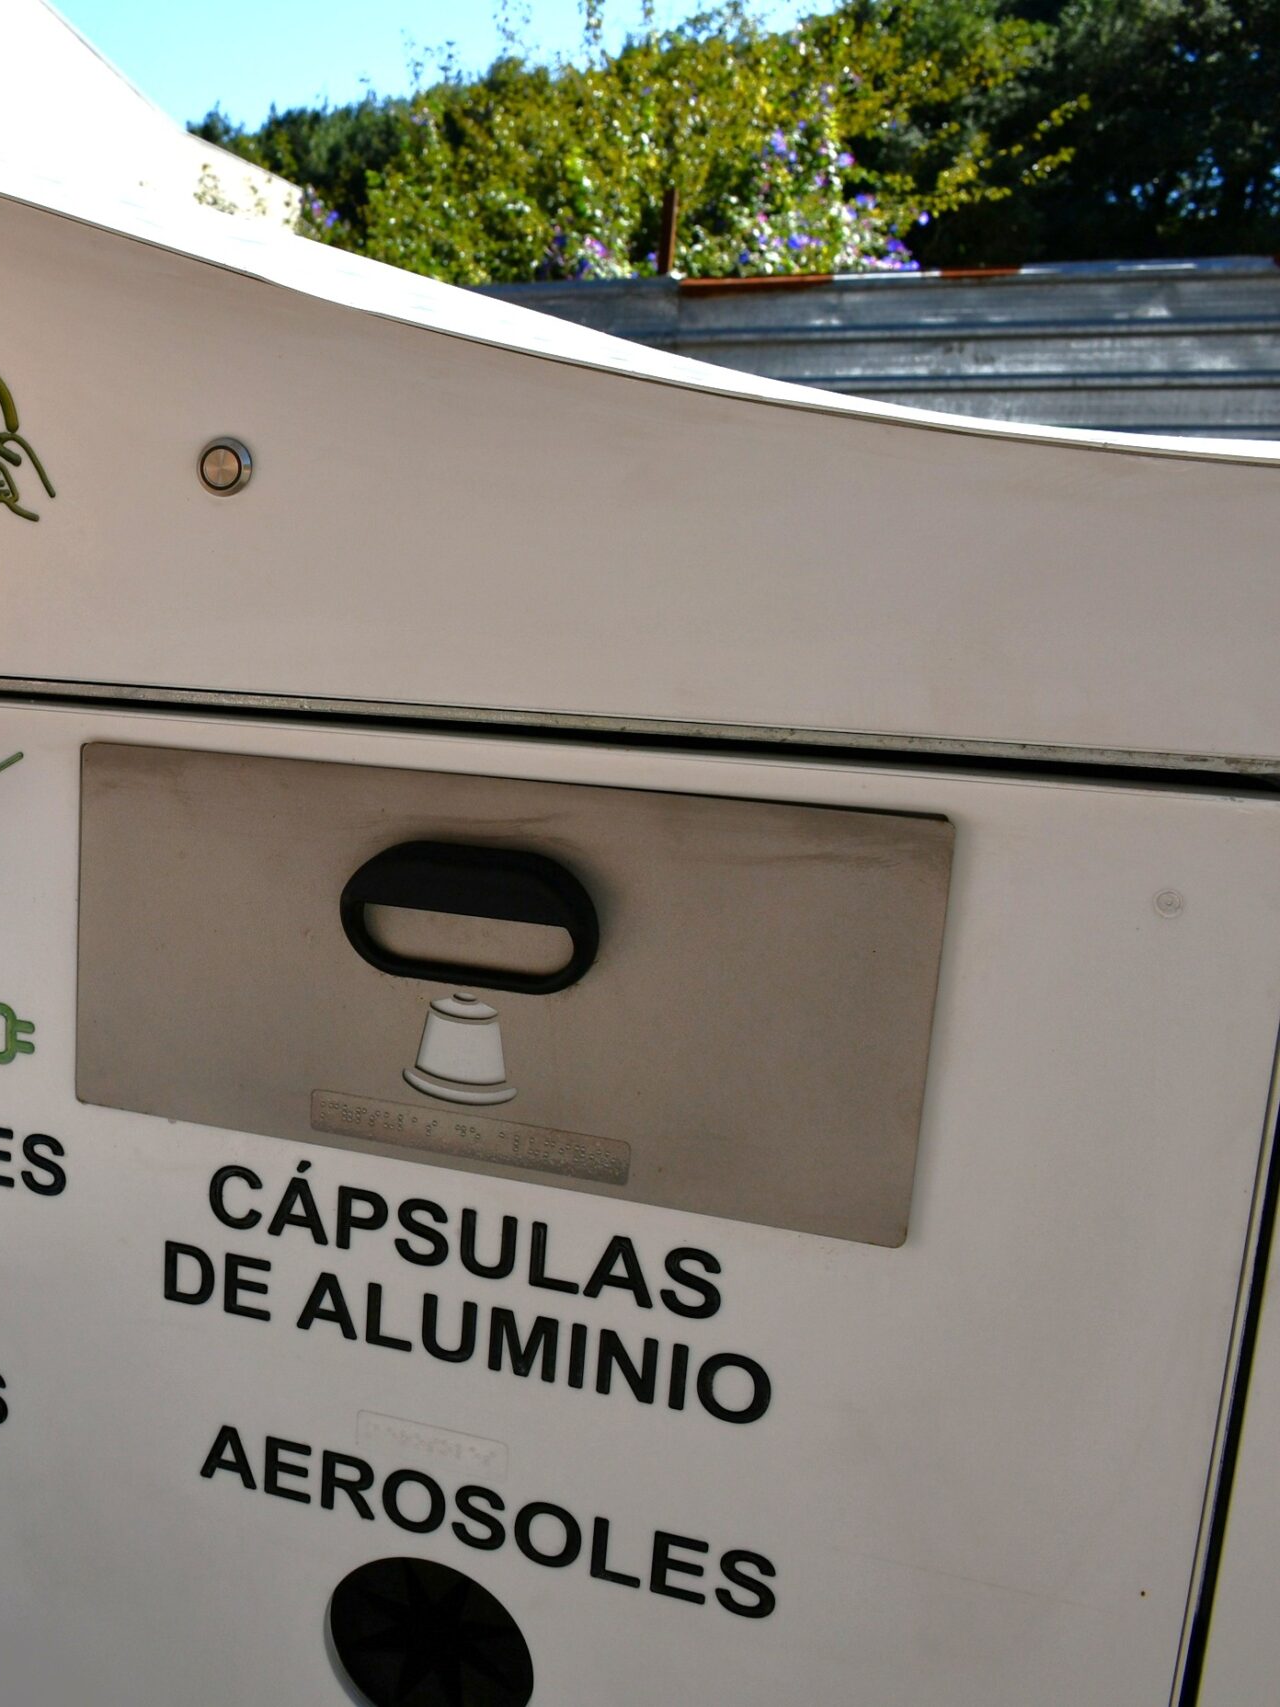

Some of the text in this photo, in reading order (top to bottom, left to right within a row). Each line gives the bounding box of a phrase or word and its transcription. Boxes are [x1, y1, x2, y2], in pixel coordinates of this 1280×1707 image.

[162, 1239, 773, 1426] DE ALUMINIO
[207, 1159, 723, 1321] CÁPSULAS
[198, 1423, 778, 1621] AEROSOLES
